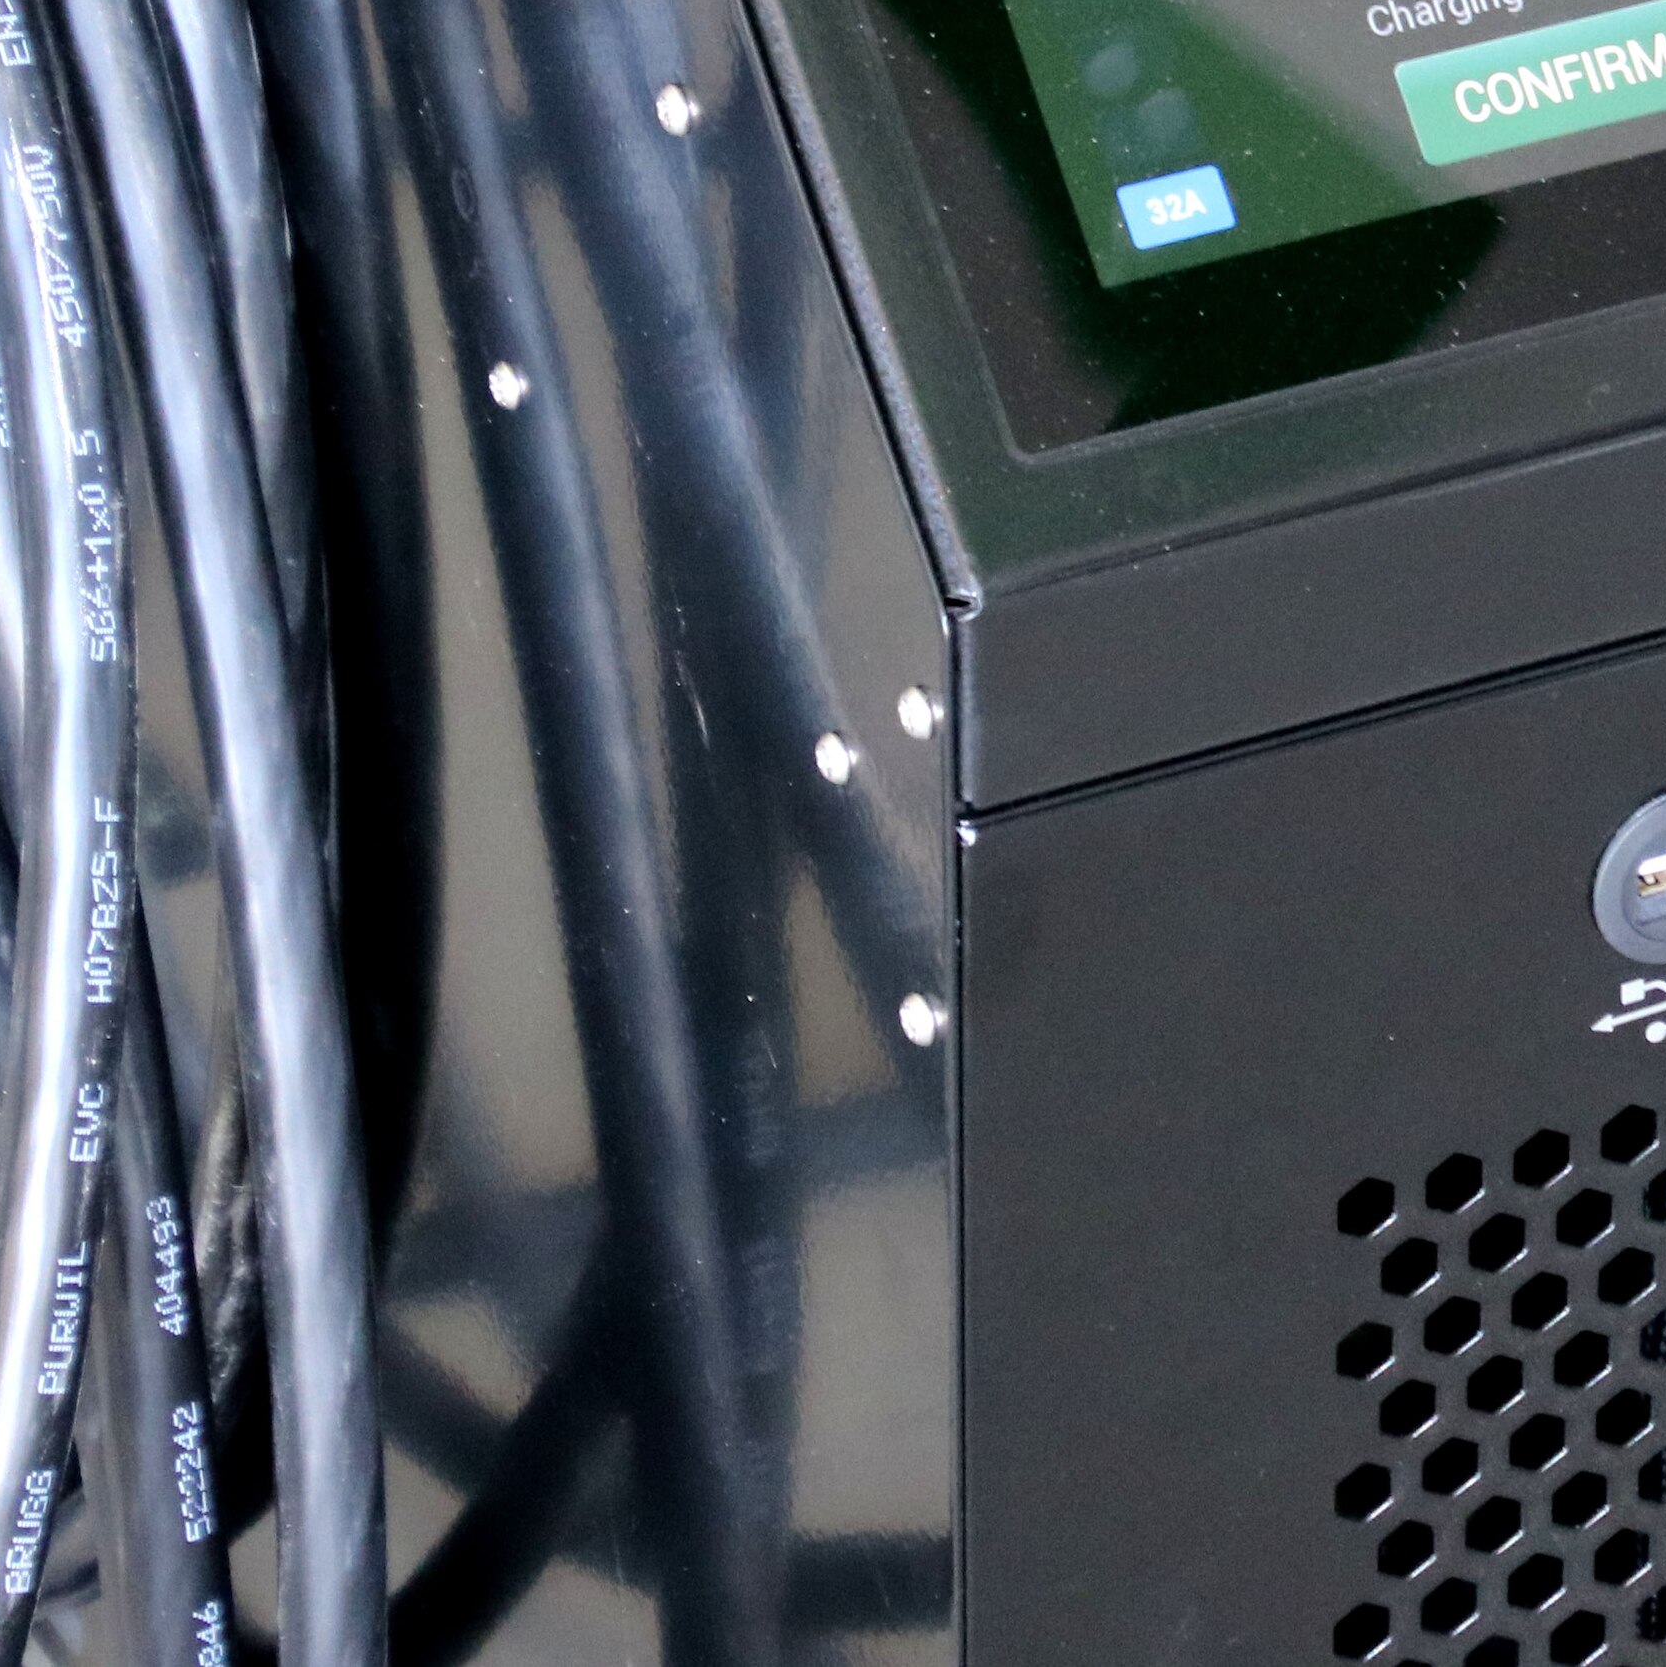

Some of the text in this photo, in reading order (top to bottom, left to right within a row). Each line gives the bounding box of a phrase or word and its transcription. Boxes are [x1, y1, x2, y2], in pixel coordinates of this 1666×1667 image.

[22, 145, 89, 349] 450/750V
[1145, 188, 1208, 226] 32A
[83, 796, 121, 1004] H07BZ5-F
[70, 1082, 105, 1164] EVC
[37, 1240, 87, 1395] PURWIL
[145, 1194, 185, 1335] 404493
[4, 1470, 54, 1595] BRUGG
[172, 1401, 213, 1544] 522242
